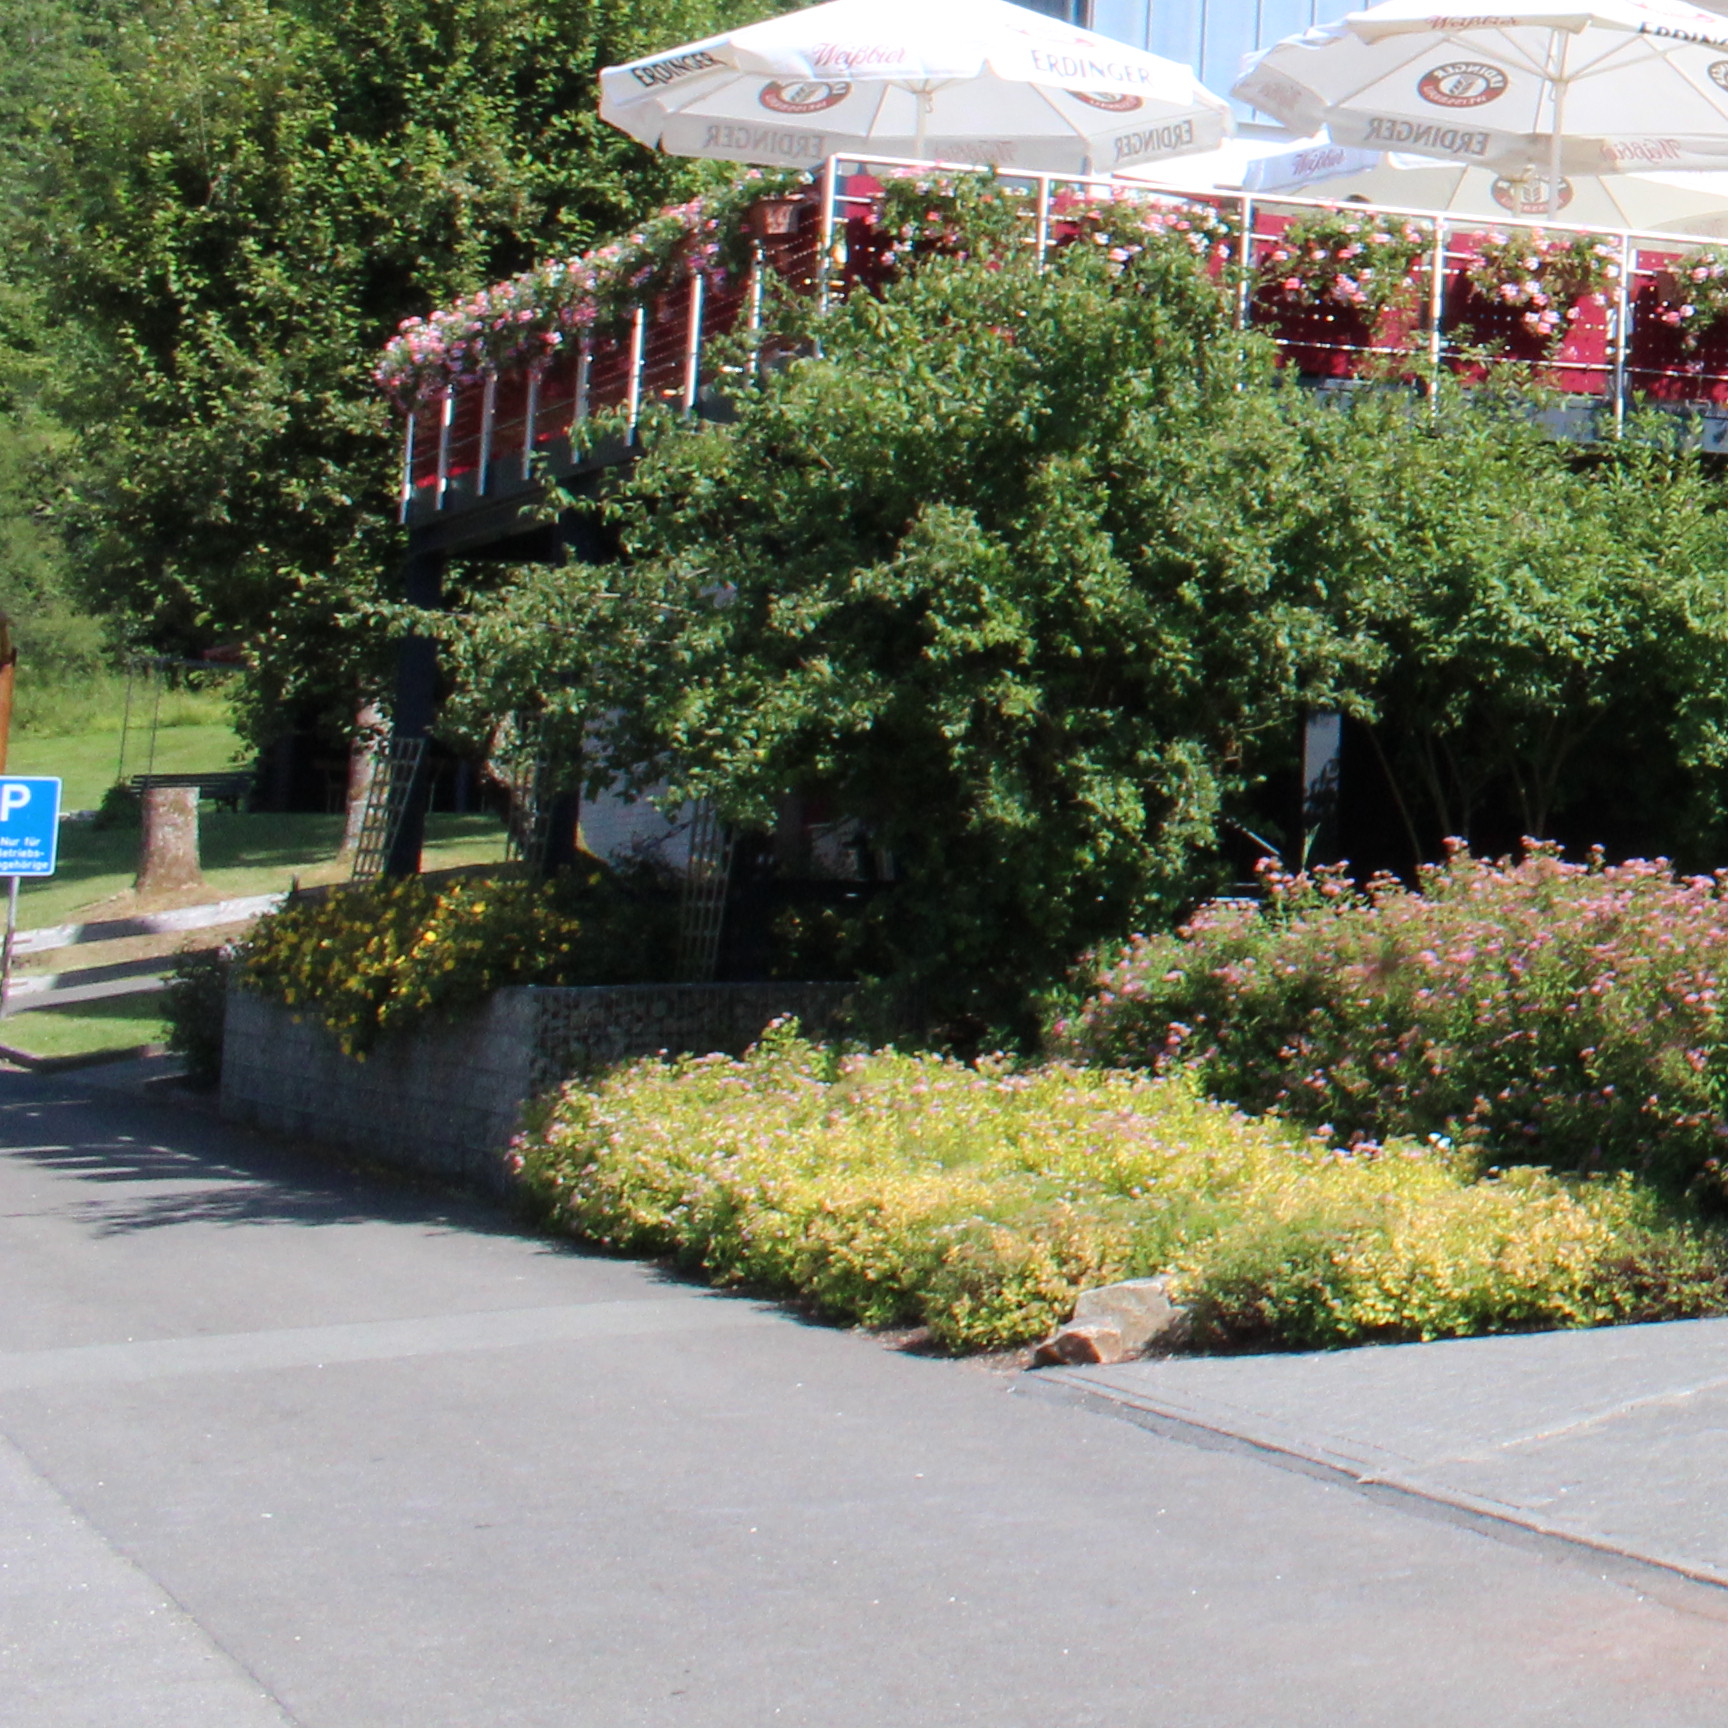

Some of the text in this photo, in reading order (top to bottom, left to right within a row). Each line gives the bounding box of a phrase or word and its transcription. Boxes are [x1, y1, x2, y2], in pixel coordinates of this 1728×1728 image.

[629, 50, 728, 88] ERDINGER
[1030, 48, 1154, 86] ERDINGER
[0, 783, 32, 822] P
